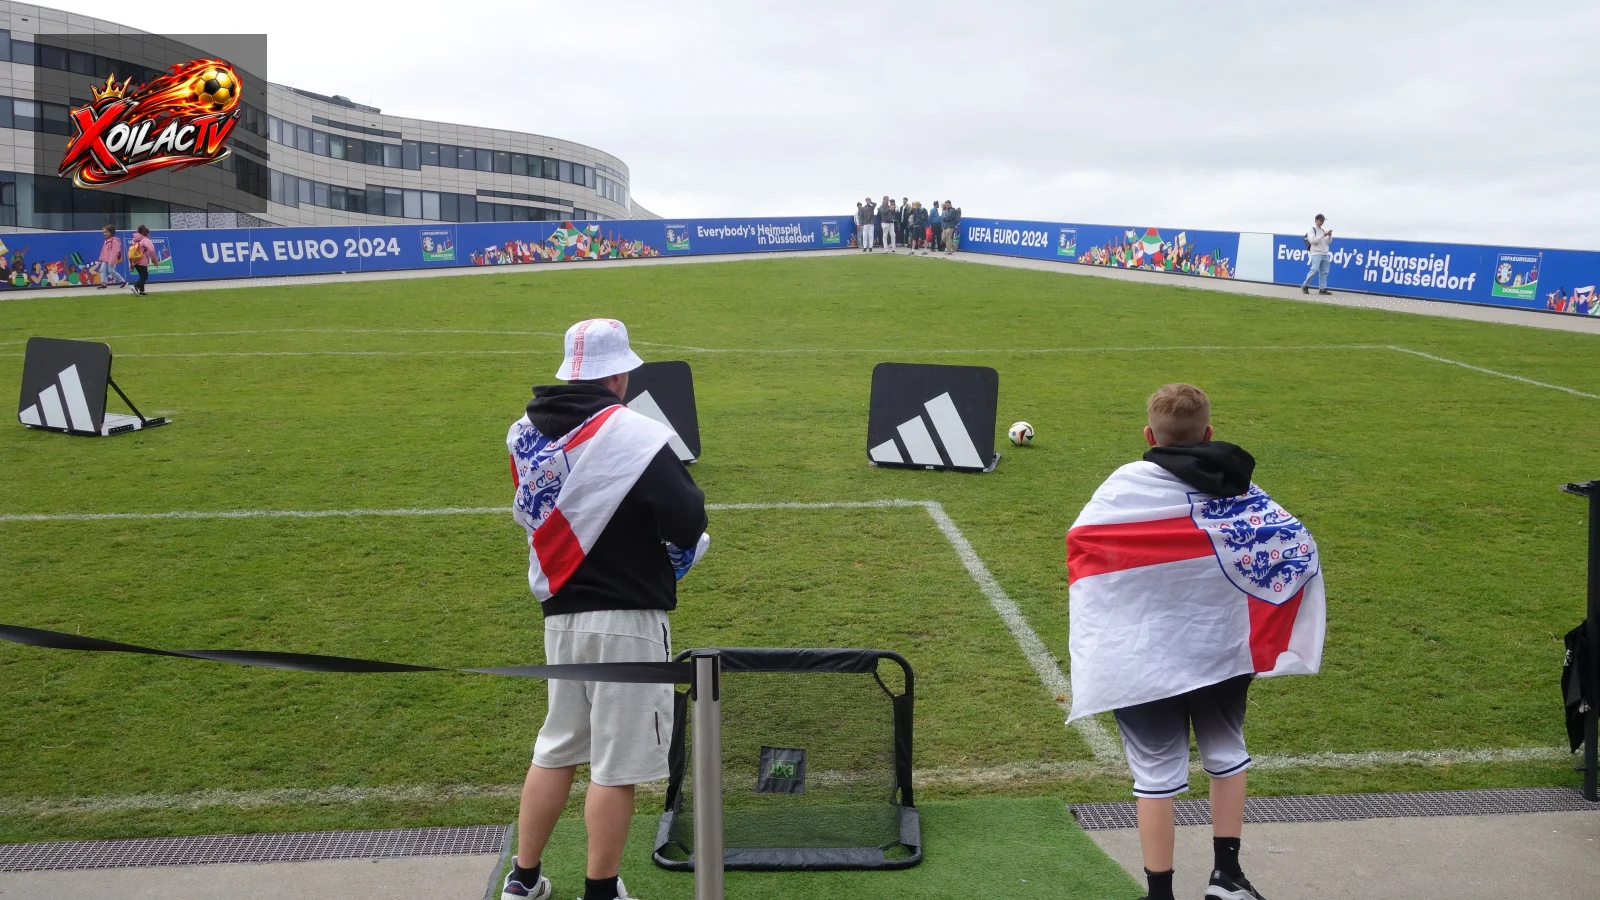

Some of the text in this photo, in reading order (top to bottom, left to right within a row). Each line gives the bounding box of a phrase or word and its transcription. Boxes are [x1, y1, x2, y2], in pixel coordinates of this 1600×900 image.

[757, 223, 801, 237] Heimspiel
[757, 236, 767, 245] in
[768, 232, 815, 244] Düsseldorf
[968, 226, 1049, 248] UEFA EURO 2024
[200, 237, 401, 264] UEFA EURO 2024
[1277, 244, 1451, 274] Everyody’s Heimspiel
[1363, 265, 1476, 291] in Düsseldorf
